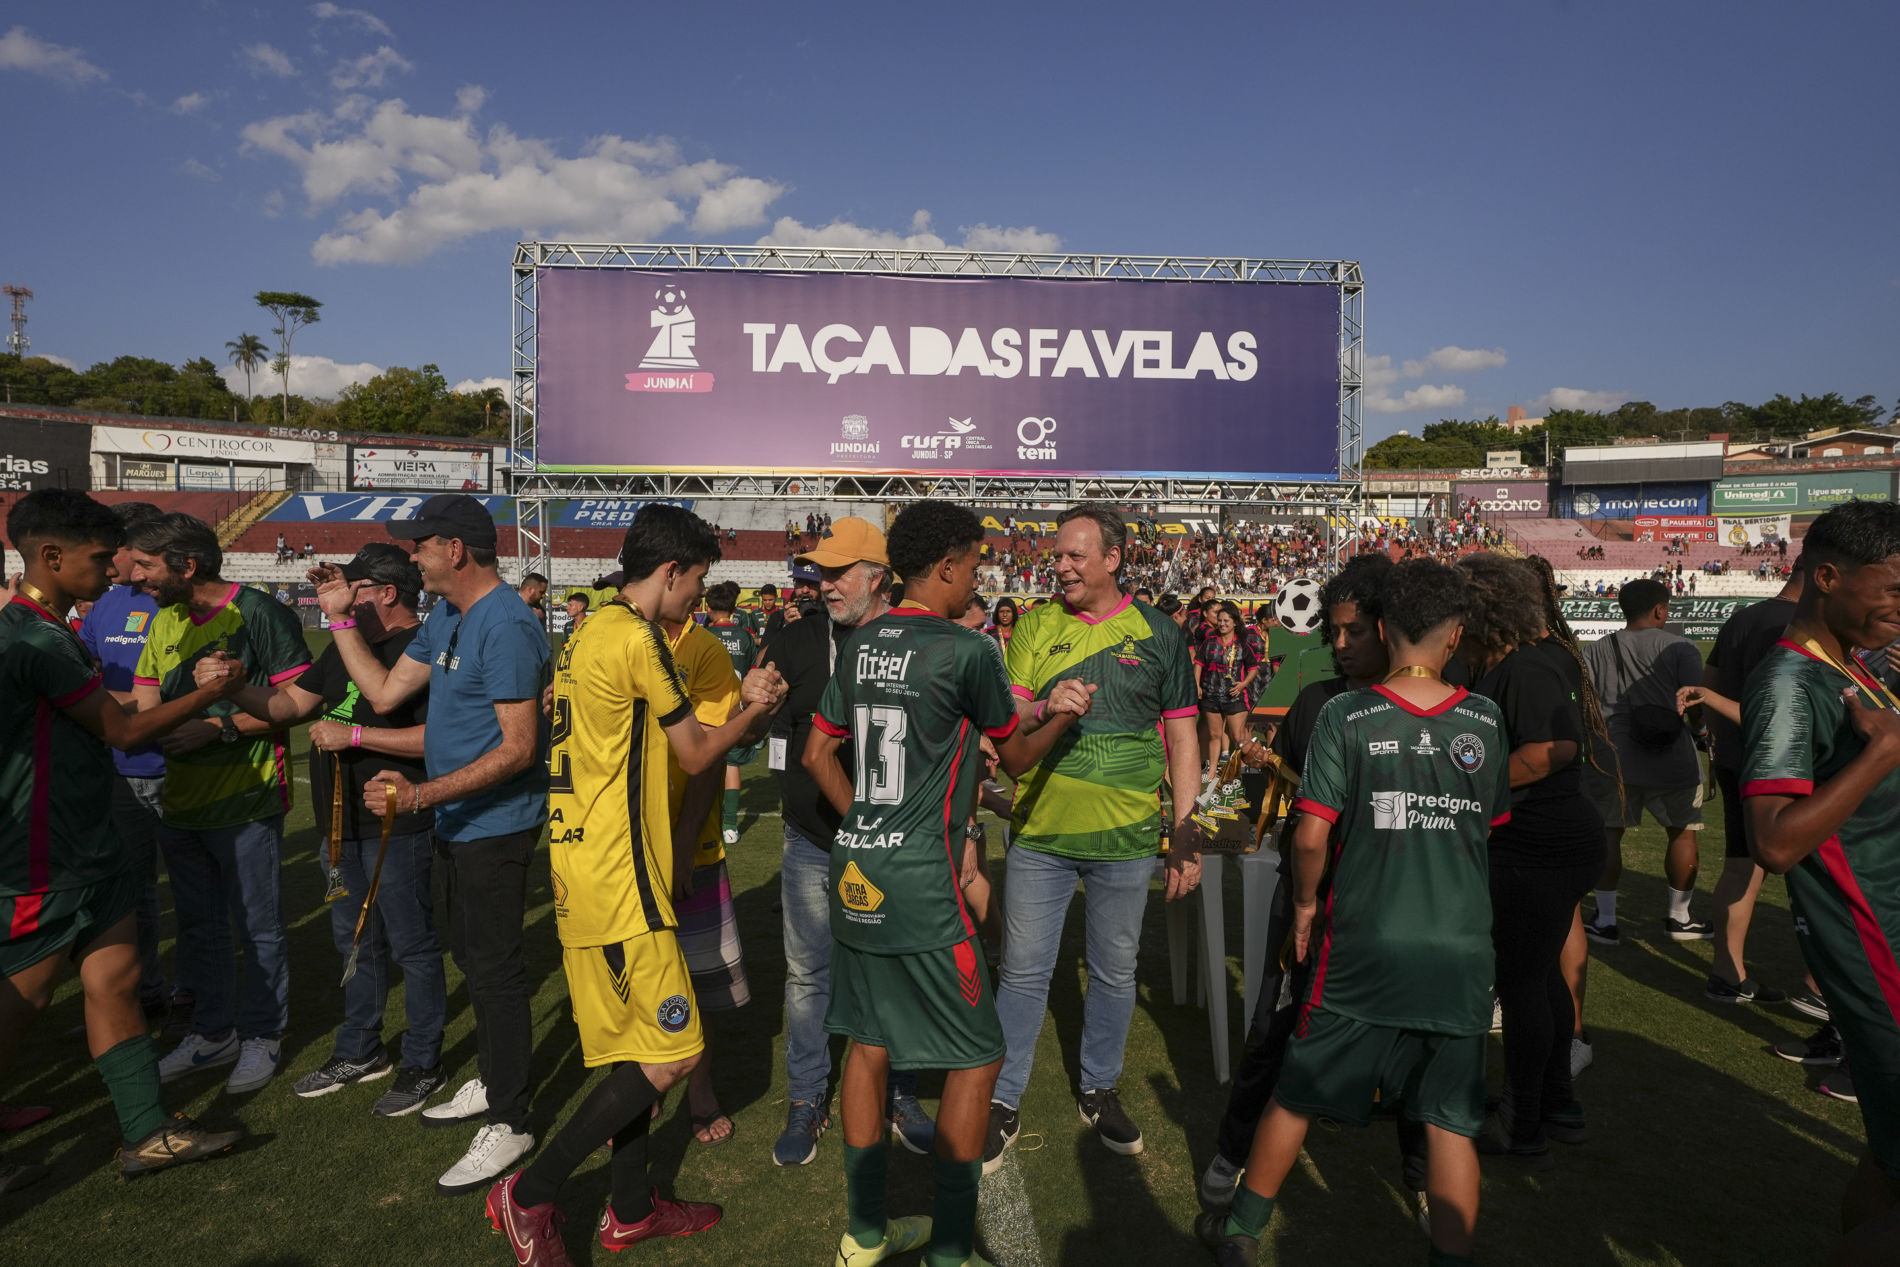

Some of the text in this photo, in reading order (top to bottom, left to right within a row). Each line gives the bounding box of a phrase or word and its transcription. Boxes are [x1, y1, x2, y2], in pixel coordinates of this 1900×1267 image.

[743, 323, 1259, 385] TAÇA DAS FAVELAS
[643, 375, 694, 390] JUNDIAÍ
[177, 436, 275, 453] CENTROCOR
[830, 440, 880, 454] JUNDIAÍ
[901, 435, 961, 449] CUFA
[912, 449, 938, 459] JUNDIAÍ
[944, 451, 953, 459] SP
[1017, 446, 1057, 460] tem
[394, 461, 436, 472] VIEIRA
[125, 468, 165, 478] MARQUES
[1724, 490, 1768, 499] Unimed
[1808, 488, 1829, 496] Ligue
[1480, 500, 1542, 512] ODONTO
[1605, 497, 1697, 510] moviecom
[574, 511, 635, 521] PRED
[1692, 601, 1737, 614] VILA
[857, 645, 913, 685] pixel
[886, 682, 909, 690] INTERNET
[903, 690, 920, 698] JEITO
[1346, 711, 1364, 722] METE
[1454, 706, 1474, 717] METE
[854, 704, 907, 805] 13
